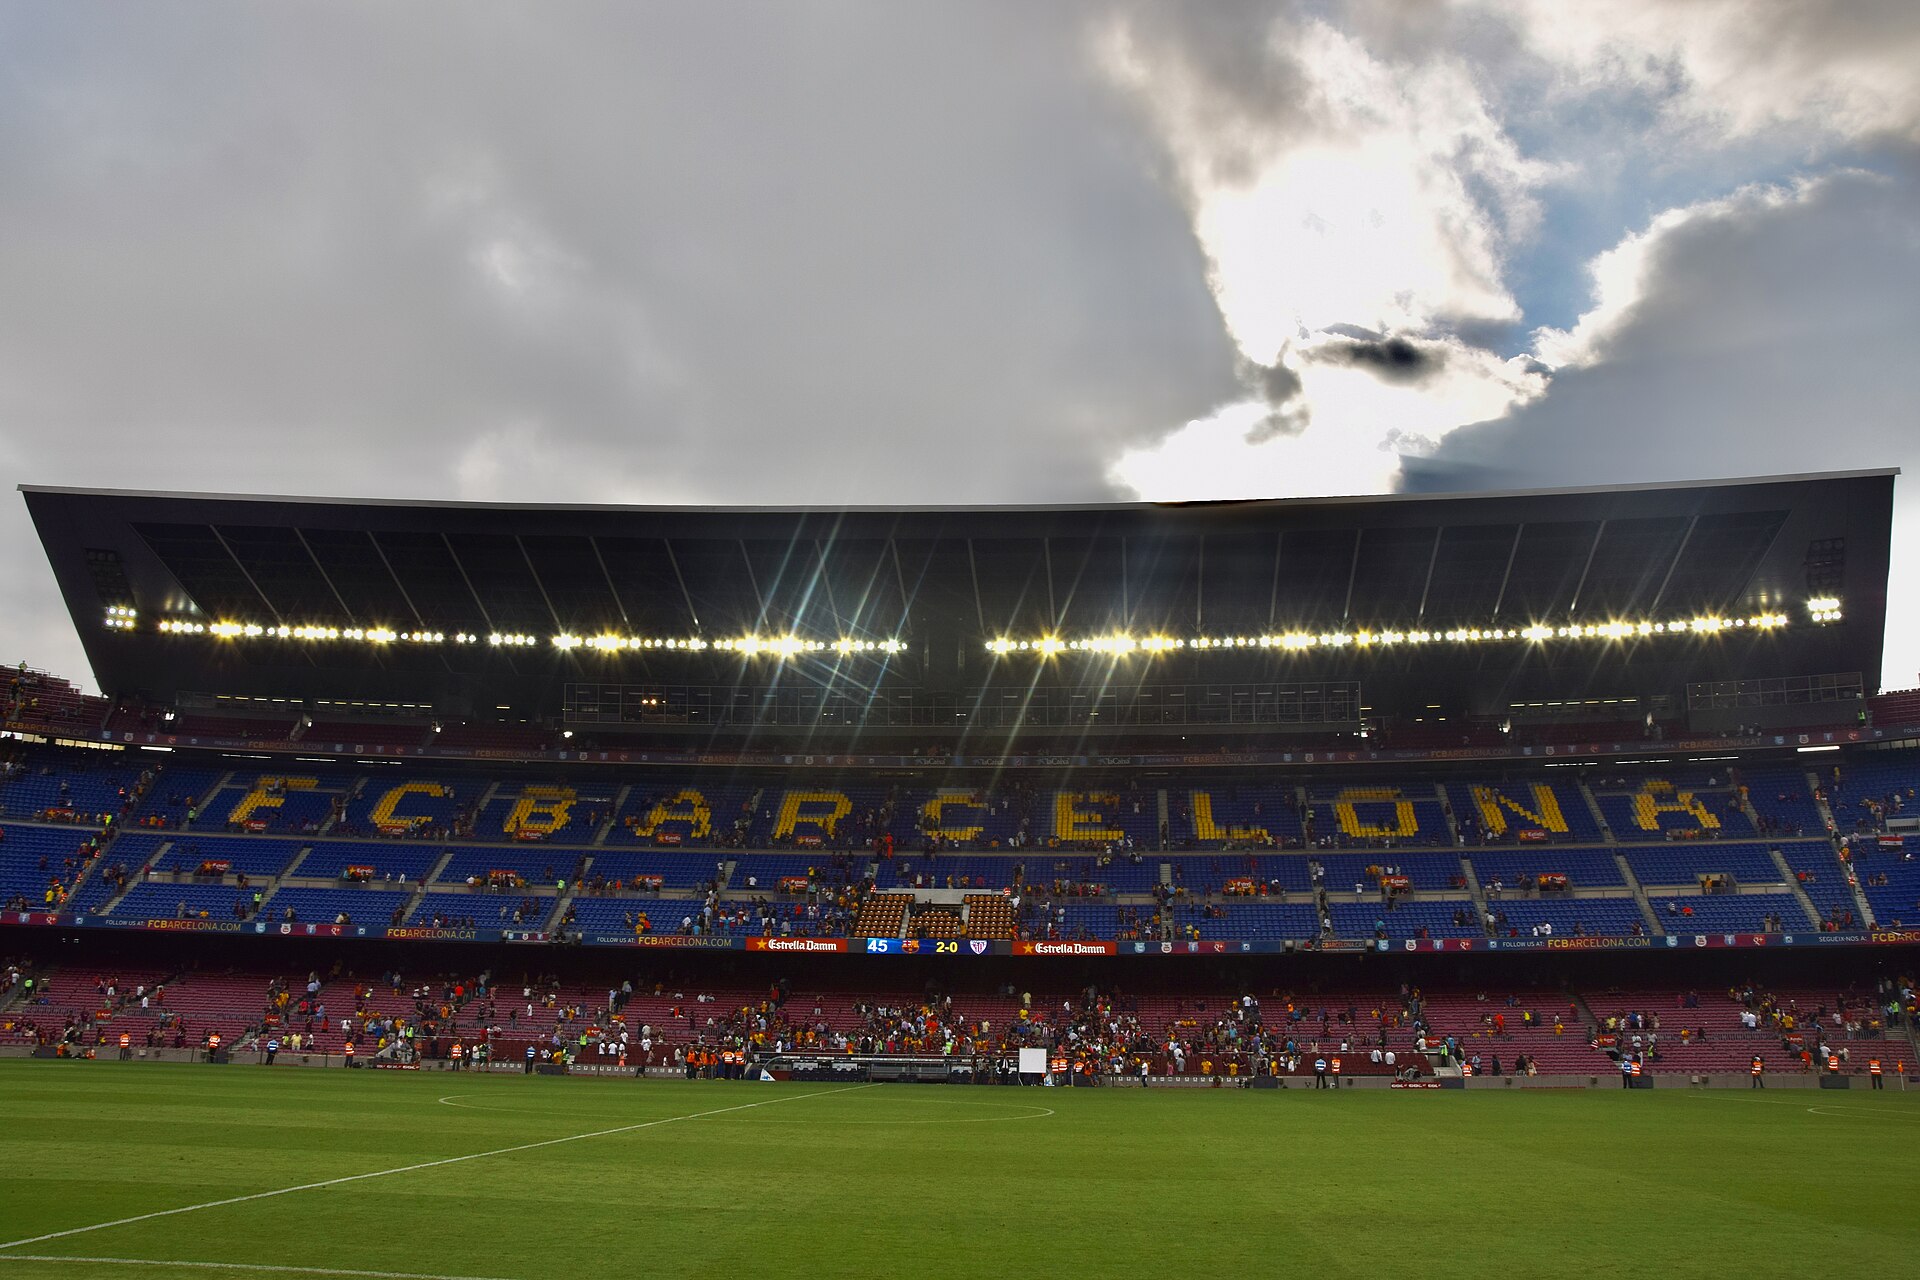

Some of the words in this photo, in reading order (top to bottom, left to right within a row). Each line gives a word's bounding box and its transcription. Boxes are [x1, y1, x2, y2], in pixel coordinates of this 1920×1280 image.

[5, 721, 89, 736] FCBARCELONA.CAT
[248, 741, 324, 750] FCBARCELONA.COM
[1679, 738, 1761, 749] FCBARCELONA.CAT
[475, 750, 547, 759] FCBARCELONA.CAT
[1431, 749, 1511, 758] FCBARCELONA.COM
[148, 920, 241, 932] FCBARCELONA.COM
[387, 928, 476, 940] FCBARCELONA.CAT
[638, 936, 732, 947] FCBARCELONA.COM
[768, 939, 804, 950] Estrella
[806, 940, 837, 950] Damm
[868, 940, 888, 952] 45
[936, 942, 958, 952] 2-0
[1502, 940, 1526, 948] FOLLOW
[1548, 937, 1650, 948] FCBARCELONA.COM
[1035, 942, 1074, 954] Estrella
[1074, 944, 1106, 954] Damm
